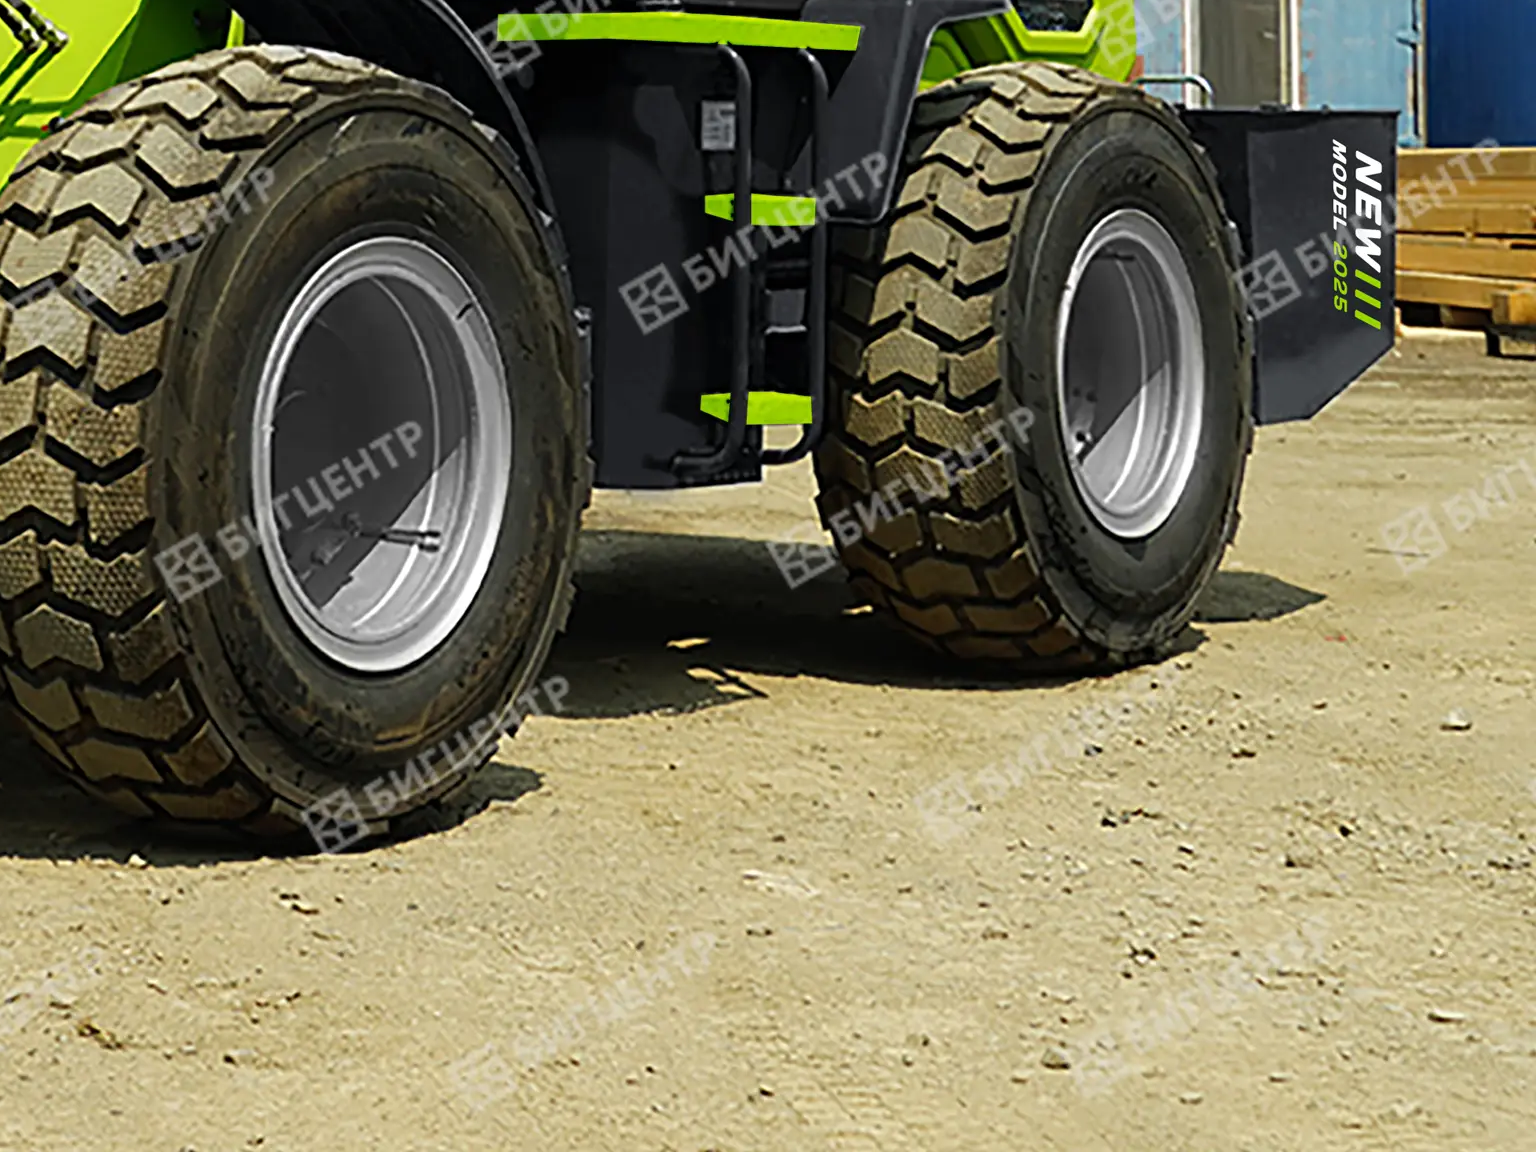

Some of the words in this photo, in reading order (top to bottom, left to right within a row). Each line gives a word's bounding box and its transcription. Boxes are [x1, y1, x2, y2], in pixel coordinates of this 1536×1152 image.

[1332, 138, 1348, 231] MODEL
[1354, 150, 1383, 273] NEW
[1332, 241, 1349, 313] 2025
